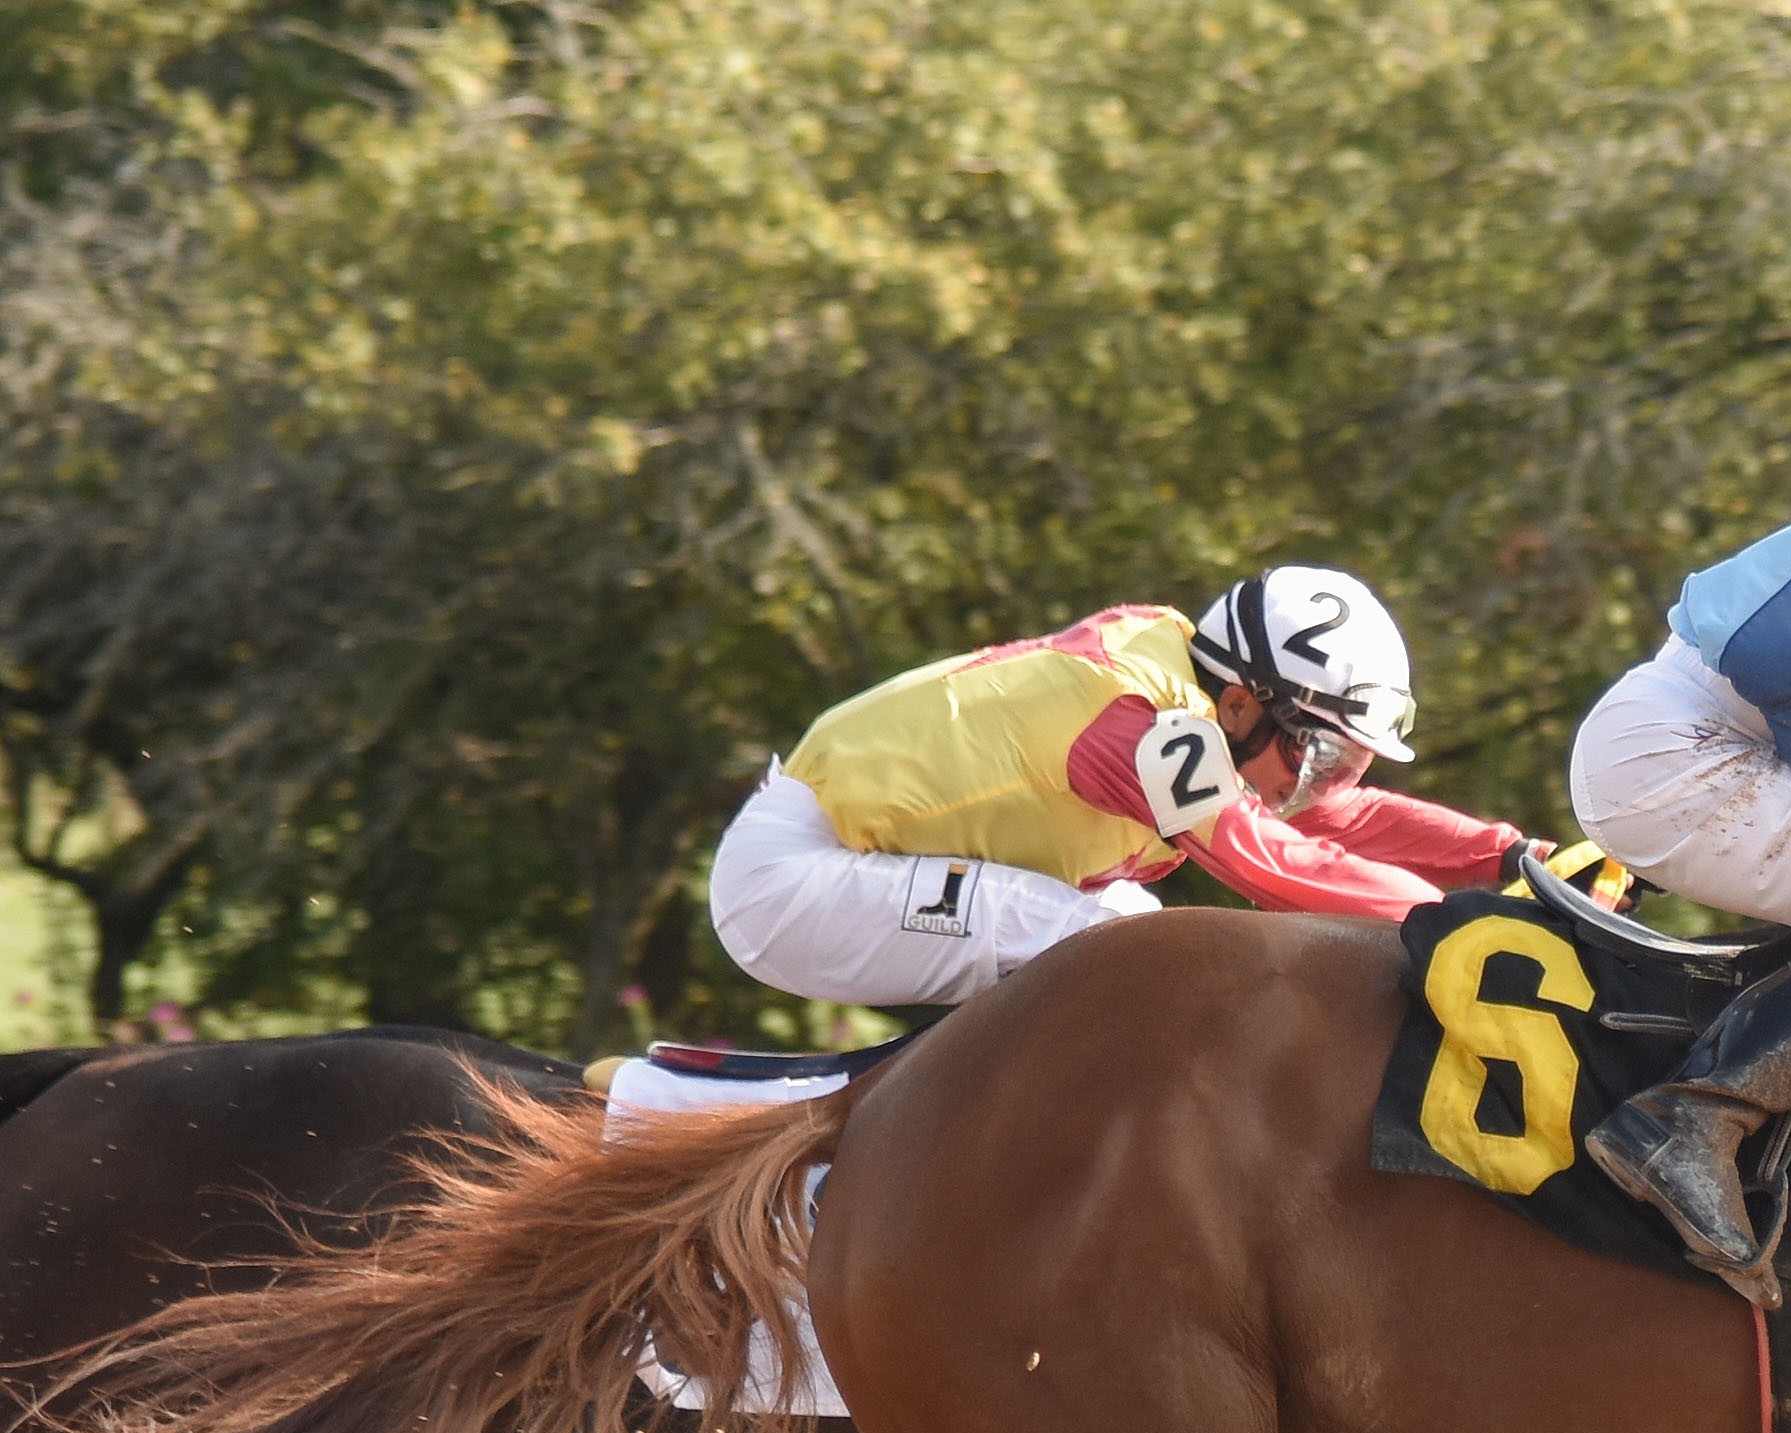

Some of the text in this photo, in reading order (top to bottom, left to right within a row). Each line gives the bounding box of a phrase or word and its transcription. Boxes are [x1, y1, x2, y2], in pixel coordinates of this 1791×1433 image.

[1281, 592, 1350, 669] 2
[1160, 733, 1221, 809] 2
[907, 915, 962, 934] GUILD
[1420, 914, 1596, 1196] 6
